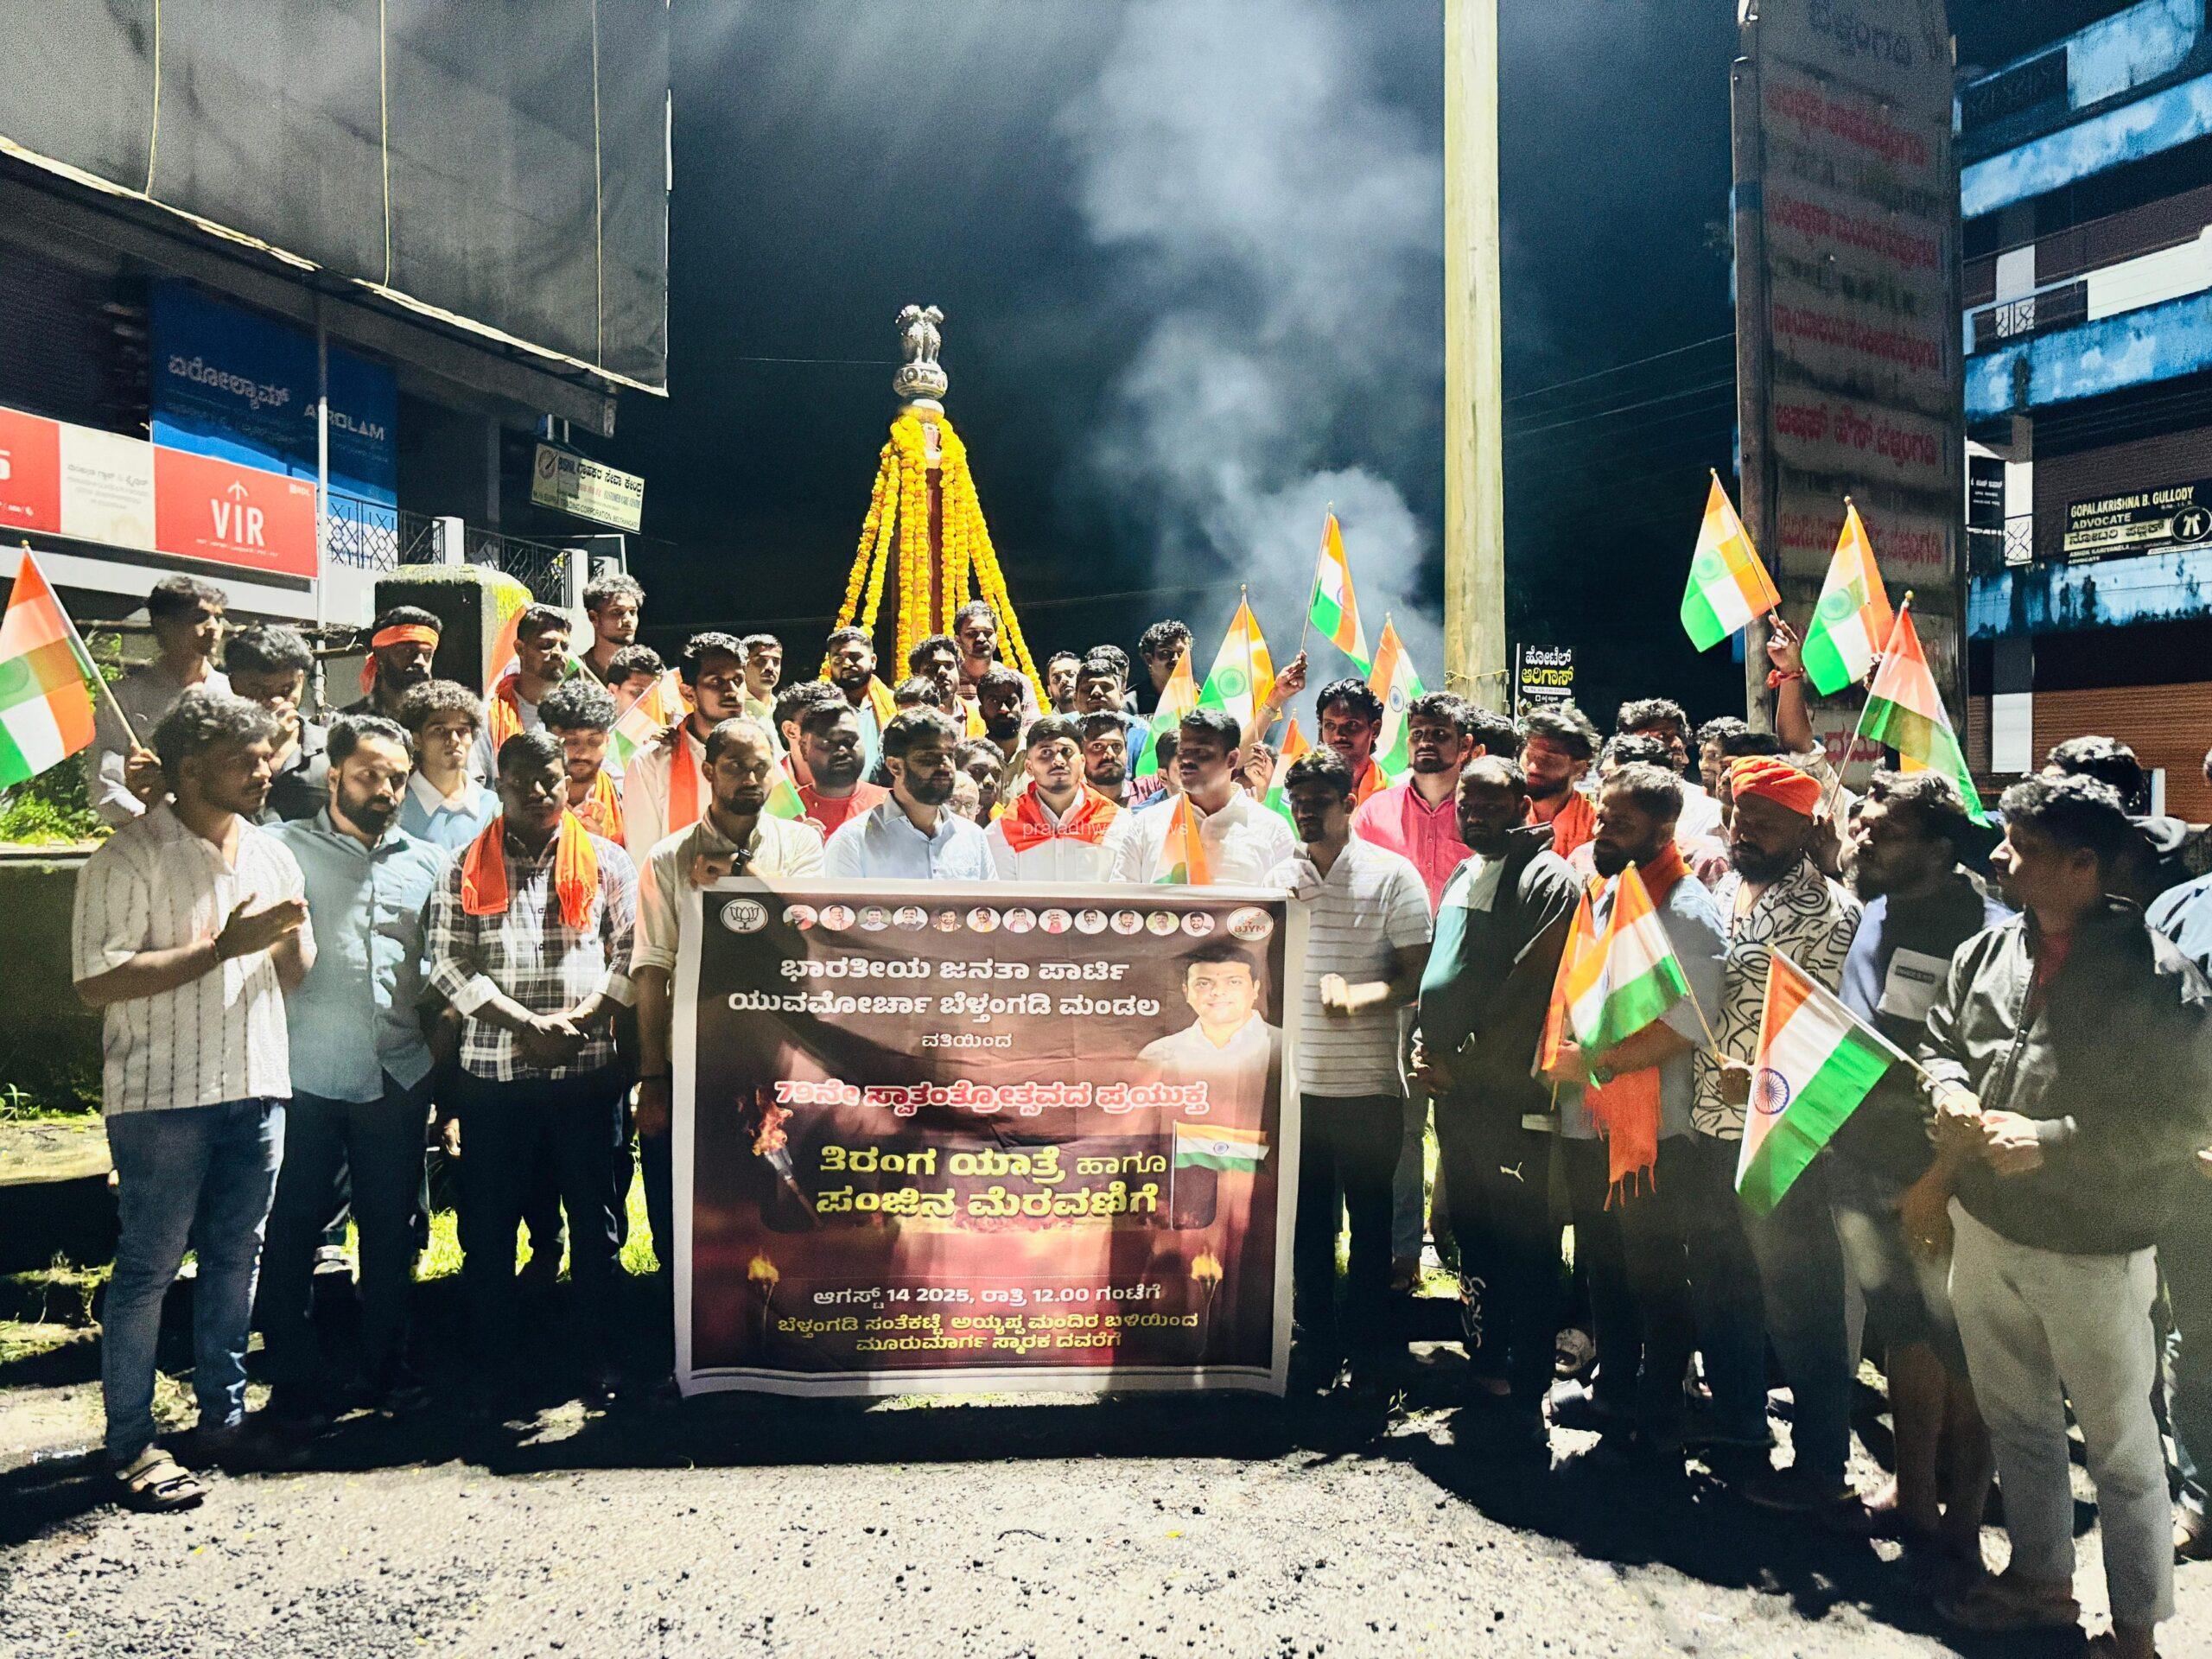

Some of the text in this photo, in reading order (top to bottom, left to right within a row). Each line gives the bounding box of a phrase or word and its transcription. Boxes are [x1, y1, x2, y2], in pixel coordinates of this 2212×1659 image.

[304, 404, 385, 442] AROLAM
[2070, 495, 2140, 518] GOPALAKRISHNA
[2142, 493, 2151, 506] B.
[2152, 486, 2195, 505] GULLODY
[211, 499, 265, 547] VIR
[2072, 512, 2132, 530] ADVOCATE
[2069, 529, 2119, 546] ನೋಟರಿ
[1525, 645, 1572, 666] ಹೋಟೆಲ್
[1234, 925, 1266, 933] BJYM
[780, 957, 1129, 982] ಭಾರತೀಯ ಜನತಾ ಪಾರ್ಟಿ
[728, 990, 1160, 1024] ಯುವಮೋರ್ಚಾ ಬೆಳ್ತಂಗಡಿ ಮಂಡಲ
[921, 1033, 1013, 1048] ವತಿಯಿಂದ
[774, 1078, 861, 1106] 79ನೇ
[1096, 1081, 1210, 1115] ಪ್ರಯುಕ್ತ
[820, 1145, 1166, 1184] ತಿರಂಗ ಯಾತ್ರೆ ಹಾಗೂ
[816, 1180, 1159, 1218] ಪಂಜಿನ ಮೆರವಣಿಗೆ
[813, 1283, 1161, 1309] ಆಗಸ್ಟ್ 14 2025, ರಾತ್ರಿ 12.00 ಗಂಟೆಗೆ
[778, 1313, 1198, 1338] ಬೆಳ್ತಂಗಡಿ ಸಂತೆಕಟ್ಟೆ ಅಯ್ಯಪ್ಪ ಮಂದಿರ ಬಳಿಯಿಂದ
[856, 1332, 1122, 1354] ಮೂರುಮಾರ್ಗ ಸ್ಮಾರಕ ದವರೆಗೆ
